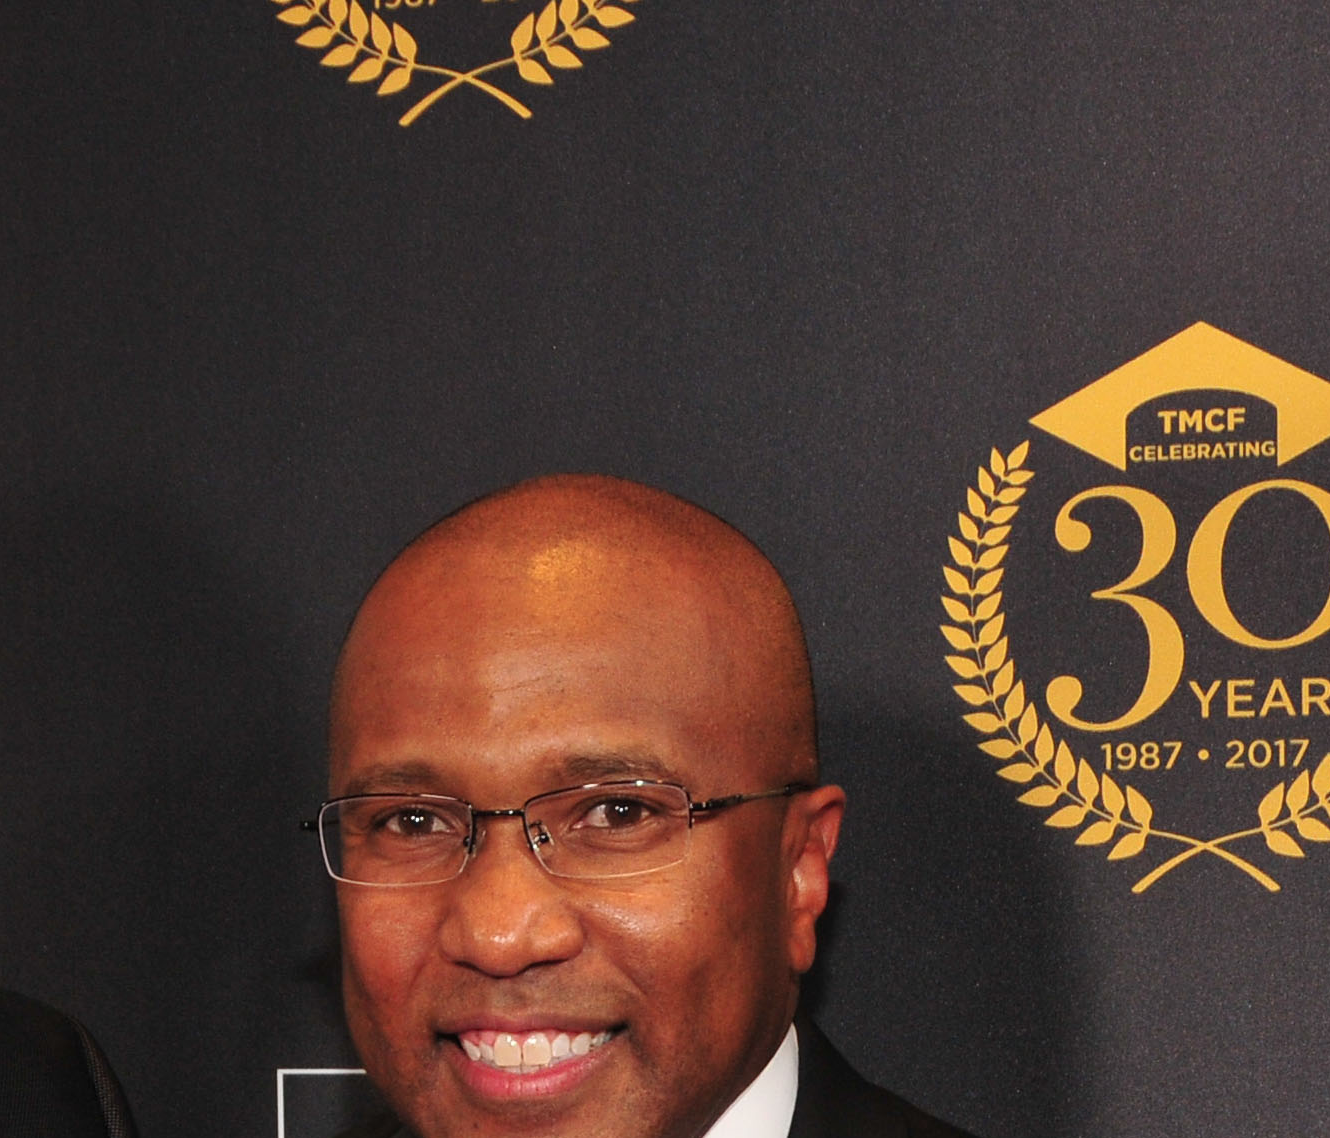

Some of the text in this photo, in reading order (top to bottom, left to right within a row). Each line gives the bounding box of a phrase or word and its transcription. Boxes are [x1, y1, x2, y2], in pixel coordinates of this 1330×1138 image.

[1157, 406, 1246, 434] TMCF
[1128, 440, 1276, 463] CELEBRATING
[1100, 738, 1311, 770] 1987 2017
